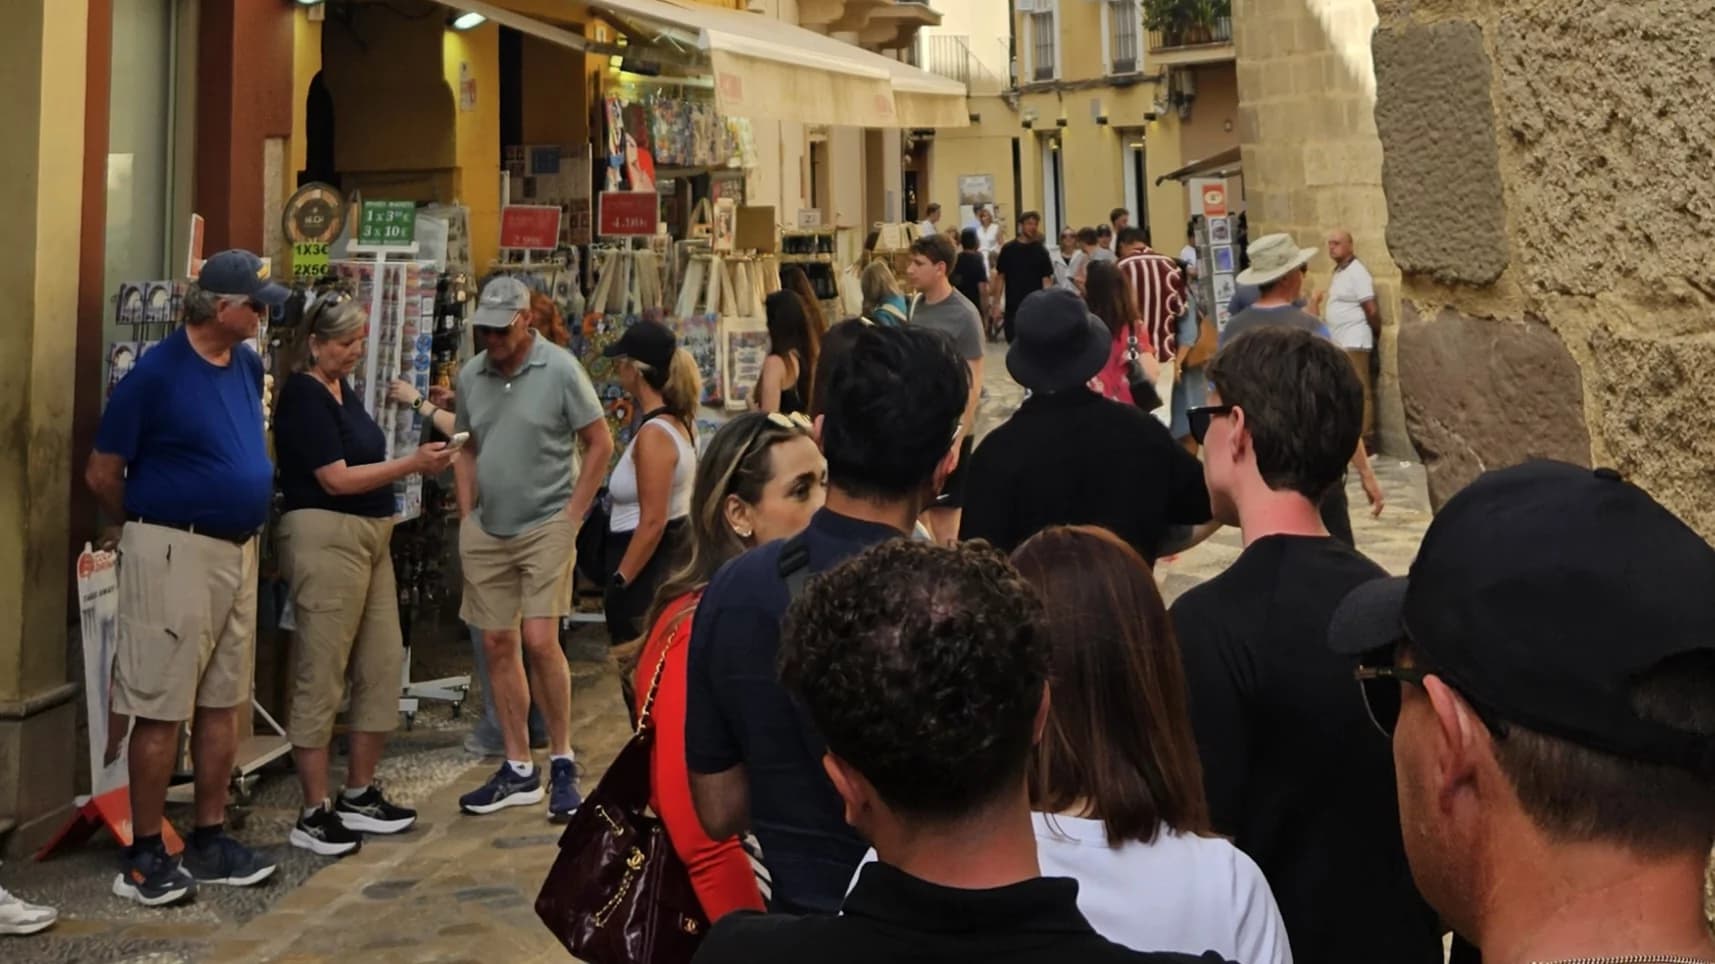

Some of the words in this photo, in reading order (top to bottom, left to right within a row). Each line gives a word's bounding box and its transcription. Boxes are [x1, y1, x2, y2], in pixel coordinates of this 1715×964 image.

[367, 210, 373, 221] 1
[363, 225, 372, 236] 3
[385, 225, 407, 237] 10€
[295, 244, 329, 256] 1X3€
[294, 264, 329, 276] 2X5€
